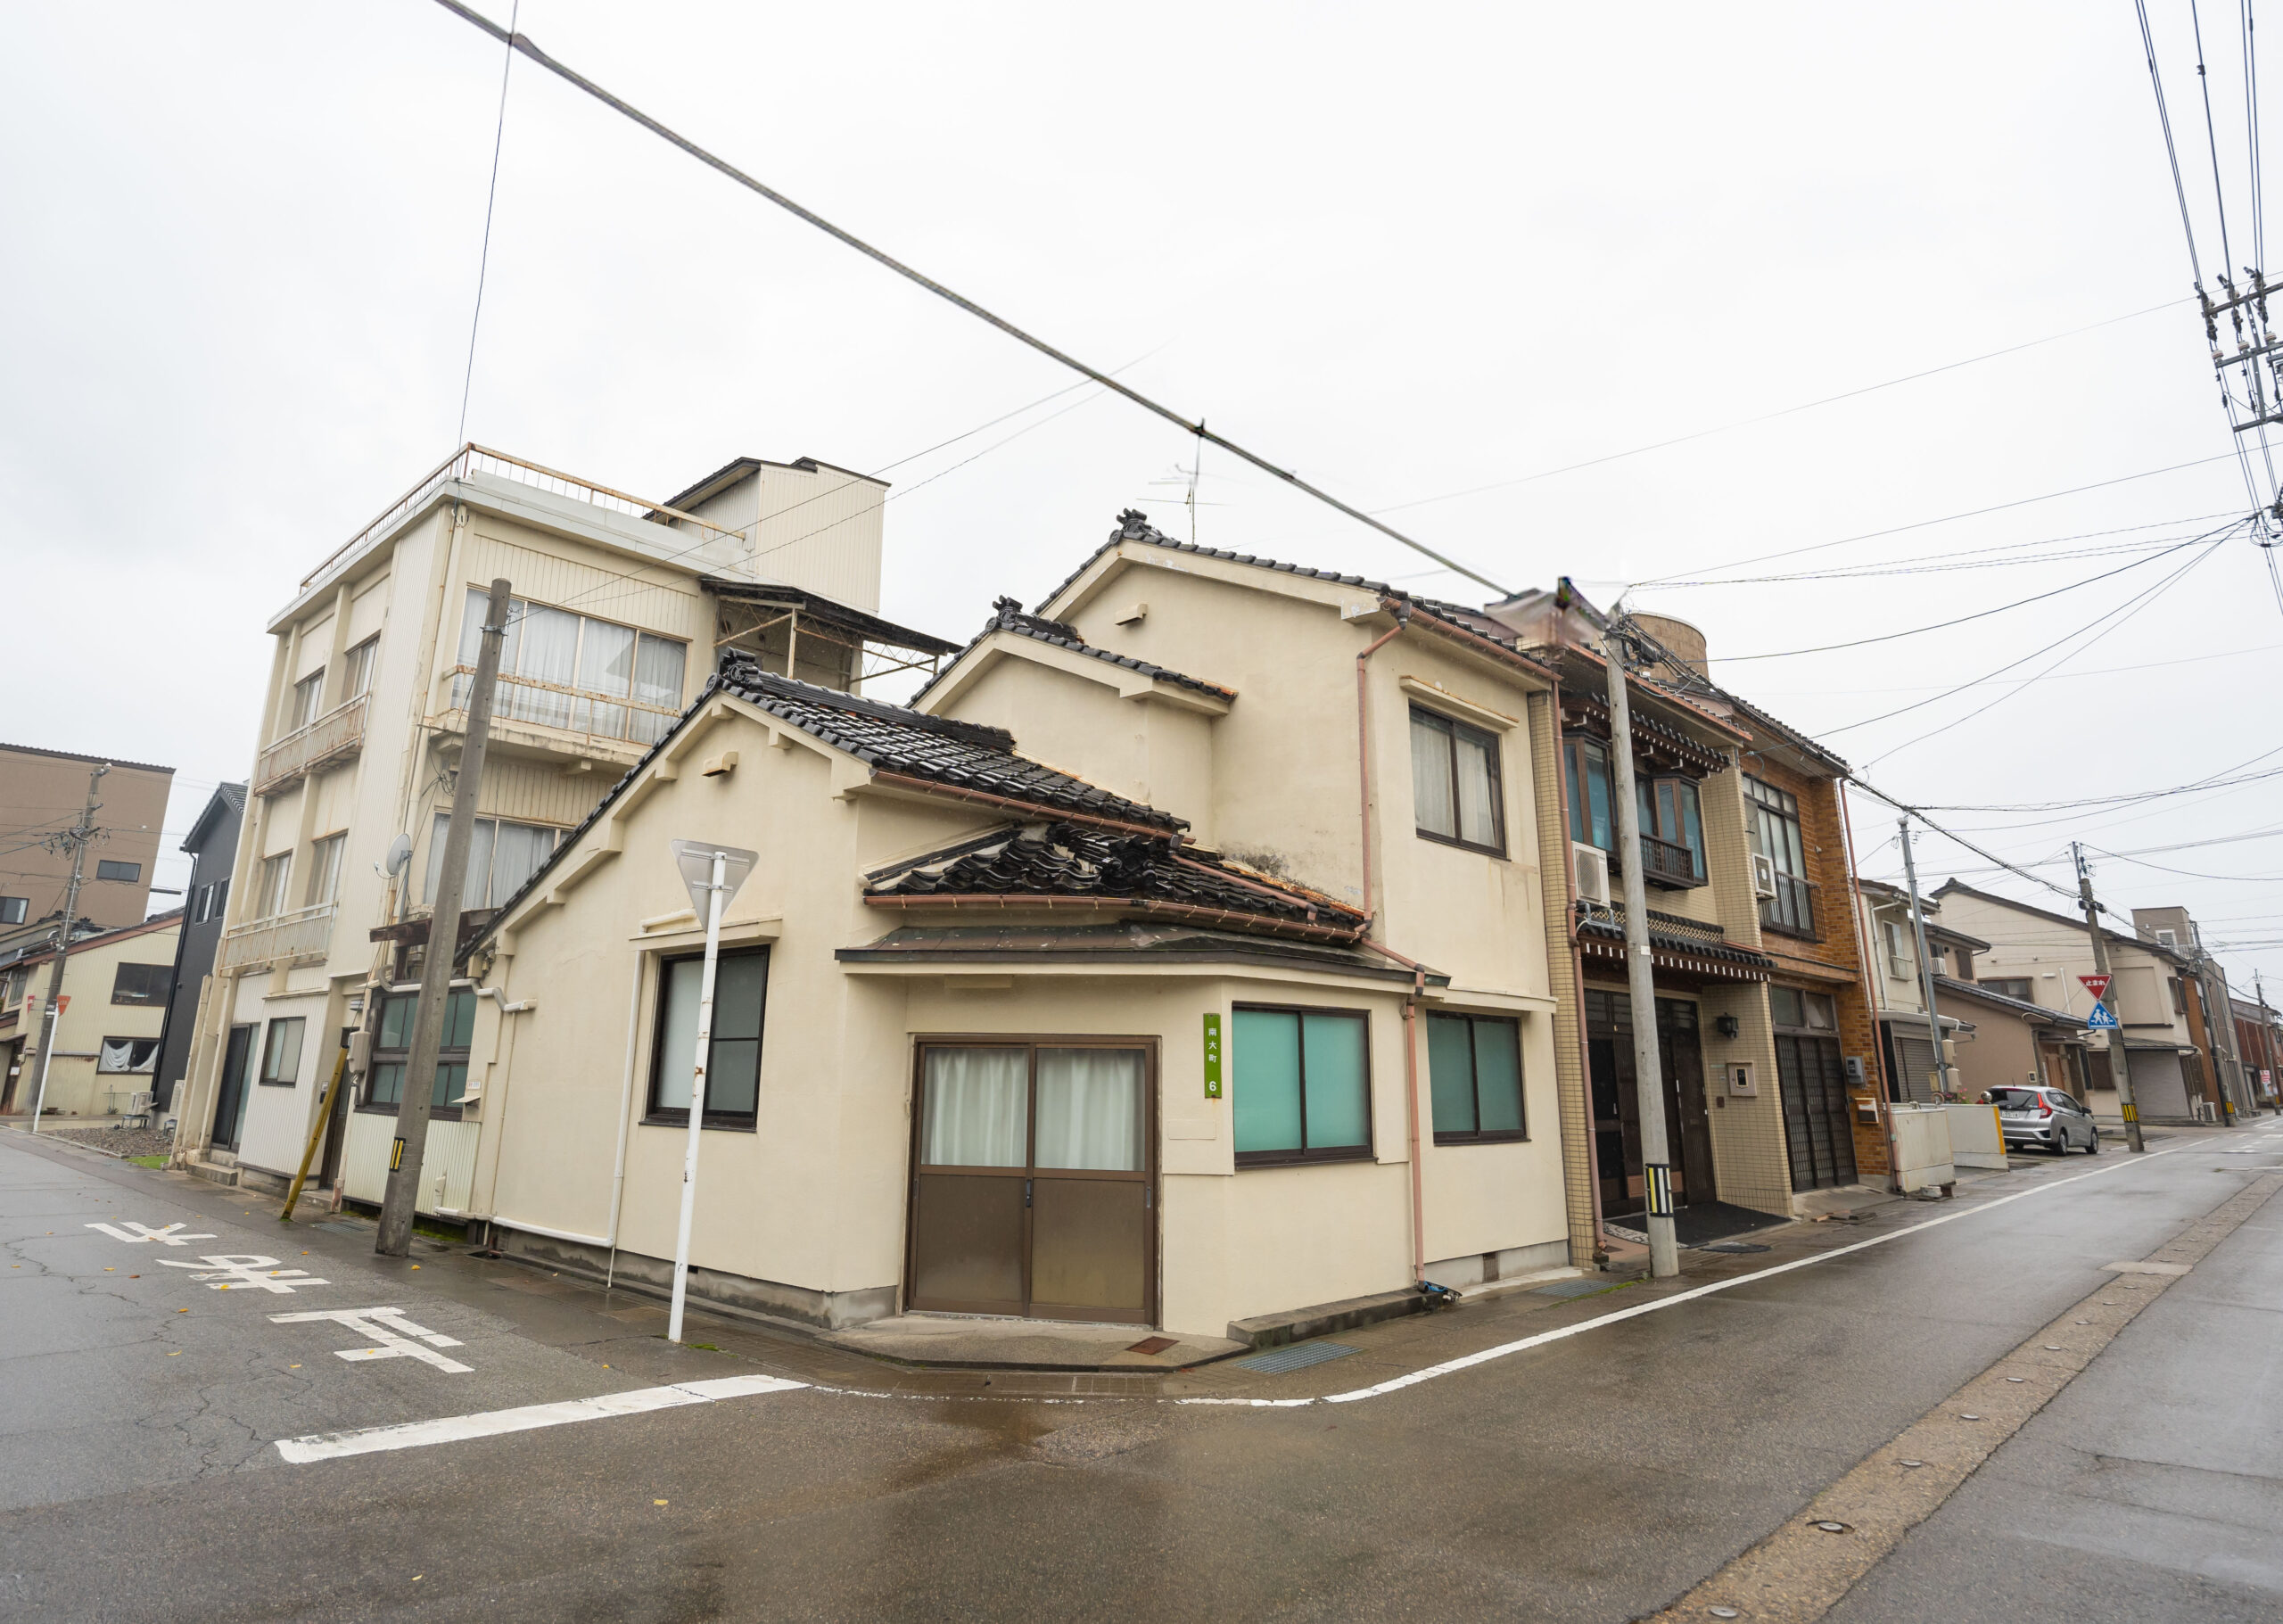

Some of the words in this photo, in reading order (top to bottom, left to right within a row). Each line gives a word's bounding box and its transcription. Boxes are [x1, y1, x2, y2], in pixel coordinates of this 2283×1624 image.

[1208, 1081, 1217, 1092] 6
[84, 1221, 474, 1373] 止まれ
